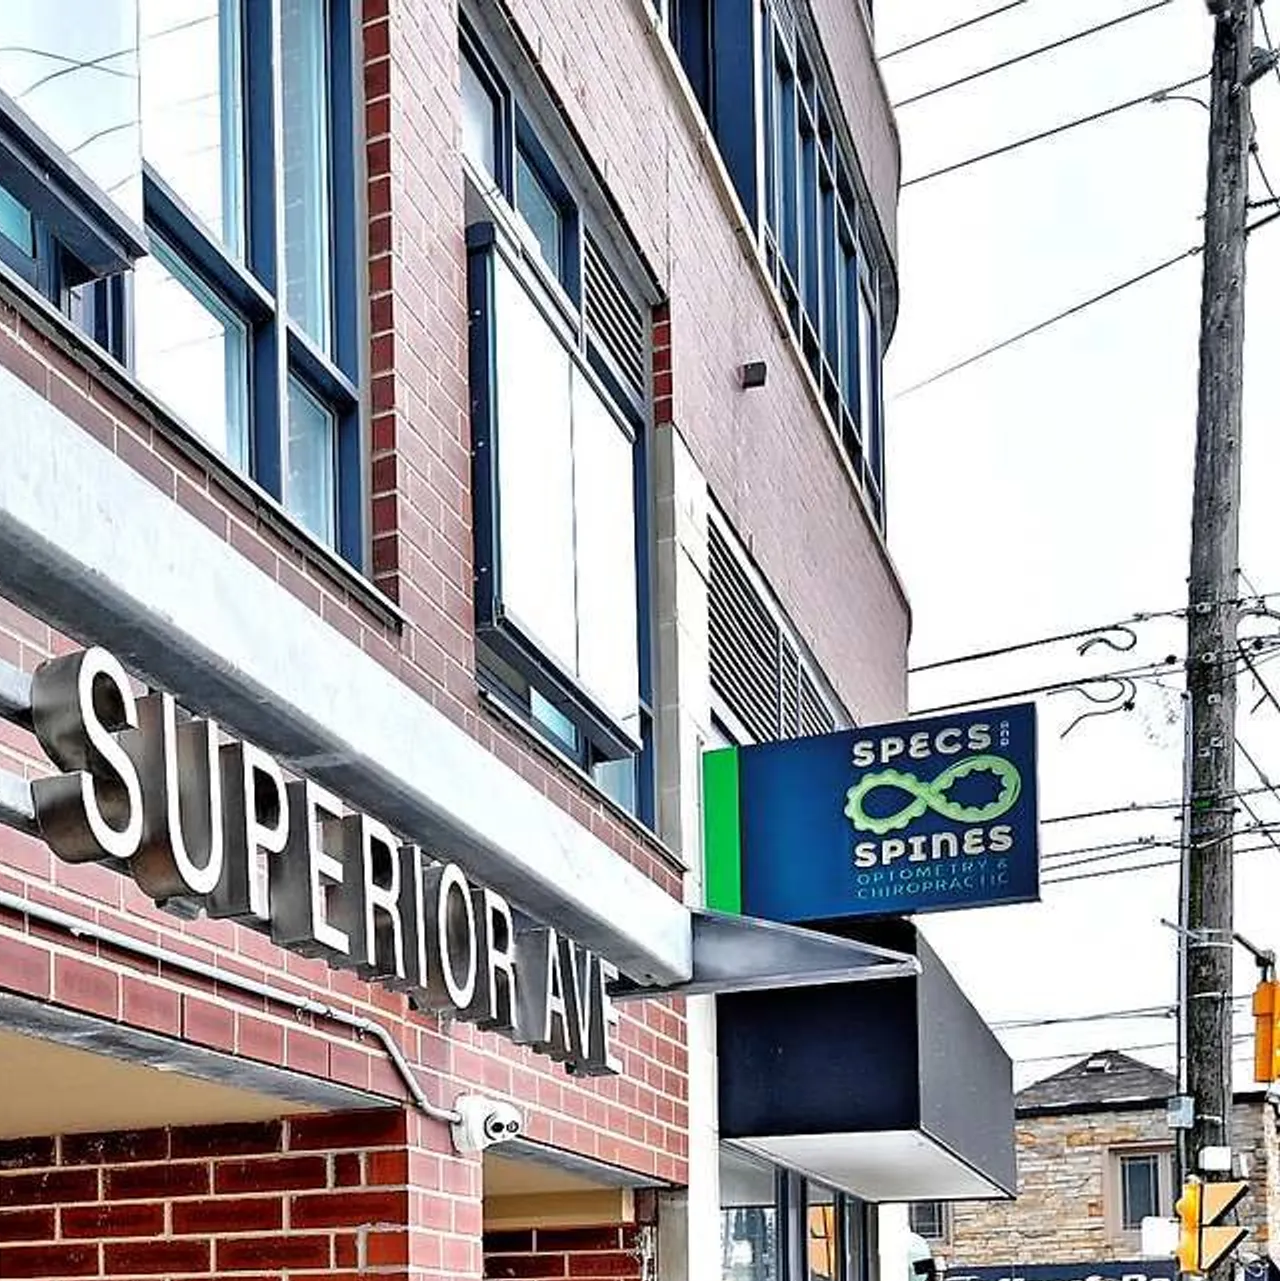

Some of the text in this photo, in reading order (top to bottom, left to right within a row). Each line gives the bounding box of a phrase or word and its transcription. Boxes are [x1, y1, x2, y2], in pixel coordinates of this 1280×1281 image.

[852, 723, 992, 768] SPECS
[36, 646, 518, 1028] SUPERIOR
[542, 926, 624, 1076] AVE
[853, 825, 1014, 868] SPINES
[856, 859, 988, 886] OPTOMETRY
[856, 872, 1010, 899] CHIROPRACTIC
